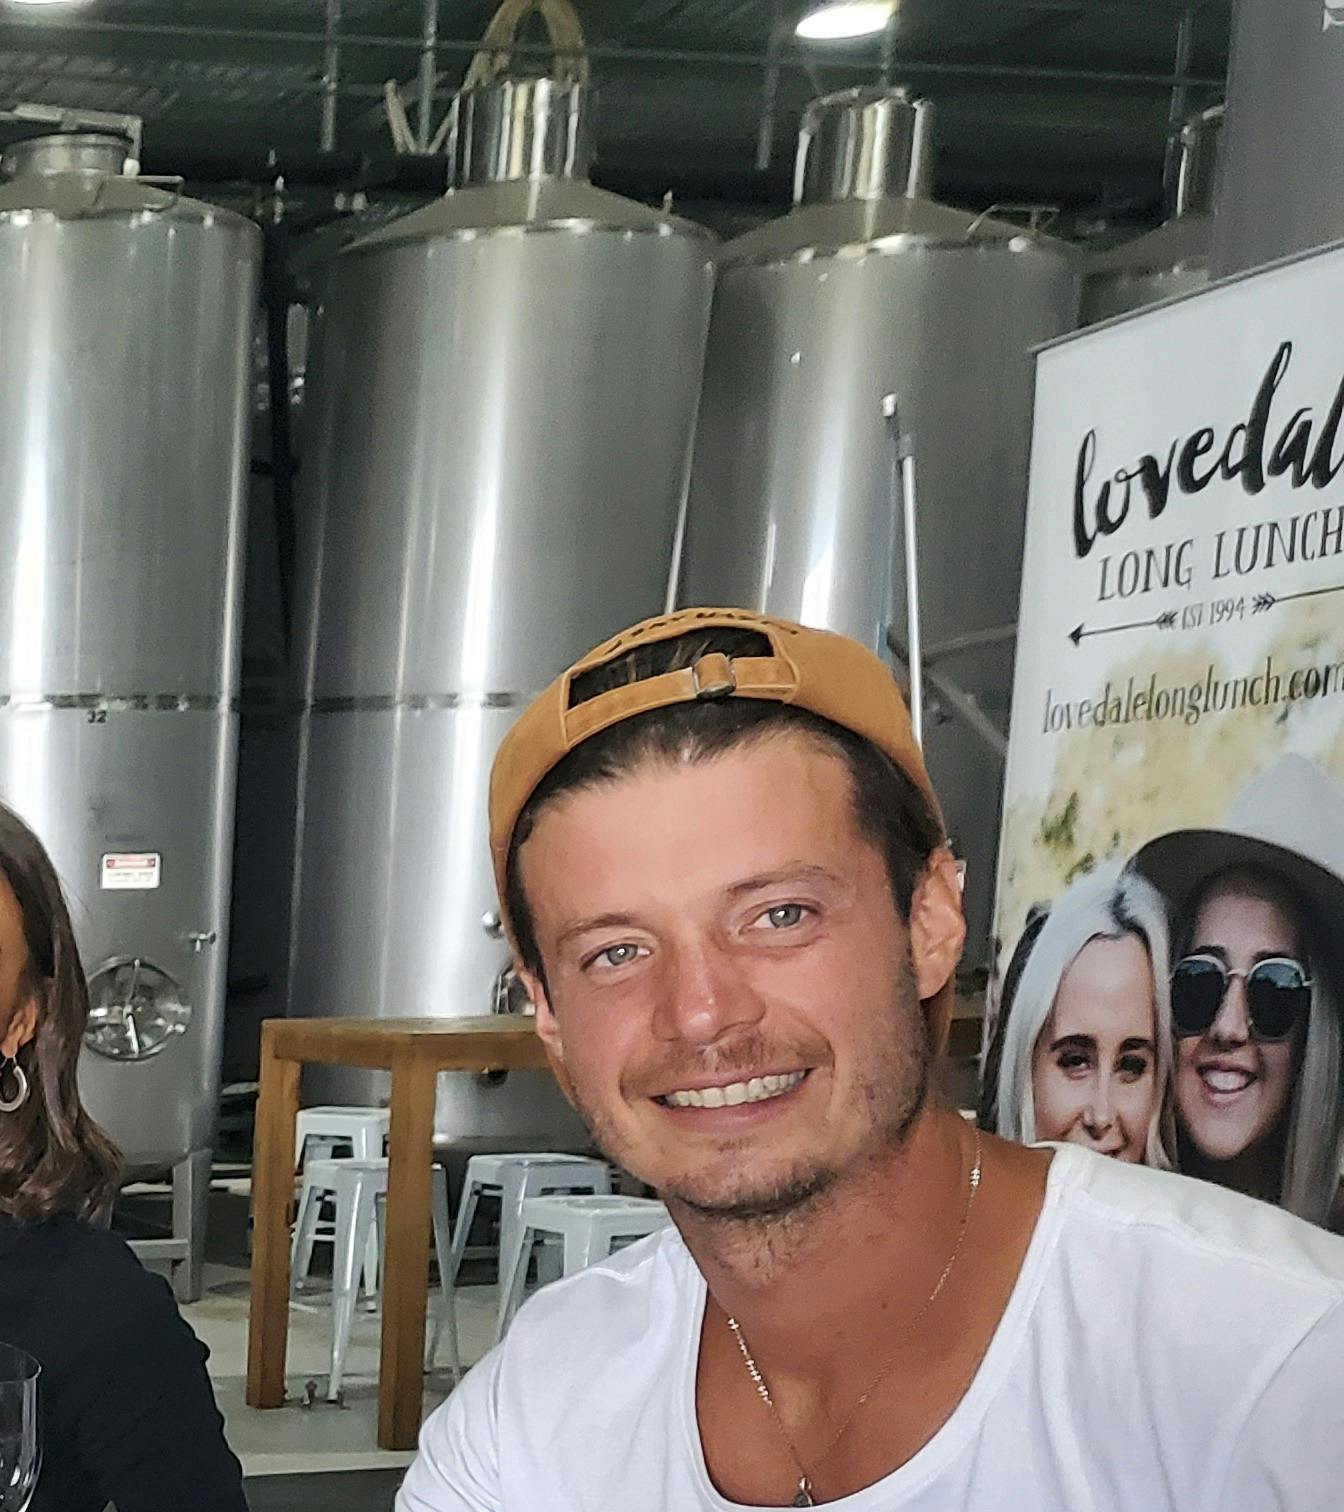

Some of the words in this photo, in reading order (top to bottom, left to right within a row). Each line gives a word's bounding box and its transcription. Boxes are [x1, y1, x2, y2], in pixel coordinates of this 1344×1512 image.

[1097, 538, 1194, 602] LONG
[1212, 505, 1344, 580] LUNCH
[1210, 596, 1246, 625] 1994
[87, 709, 107, 724] 32
[1041, 656, 1344, 734] lovedalelonglunch.com
